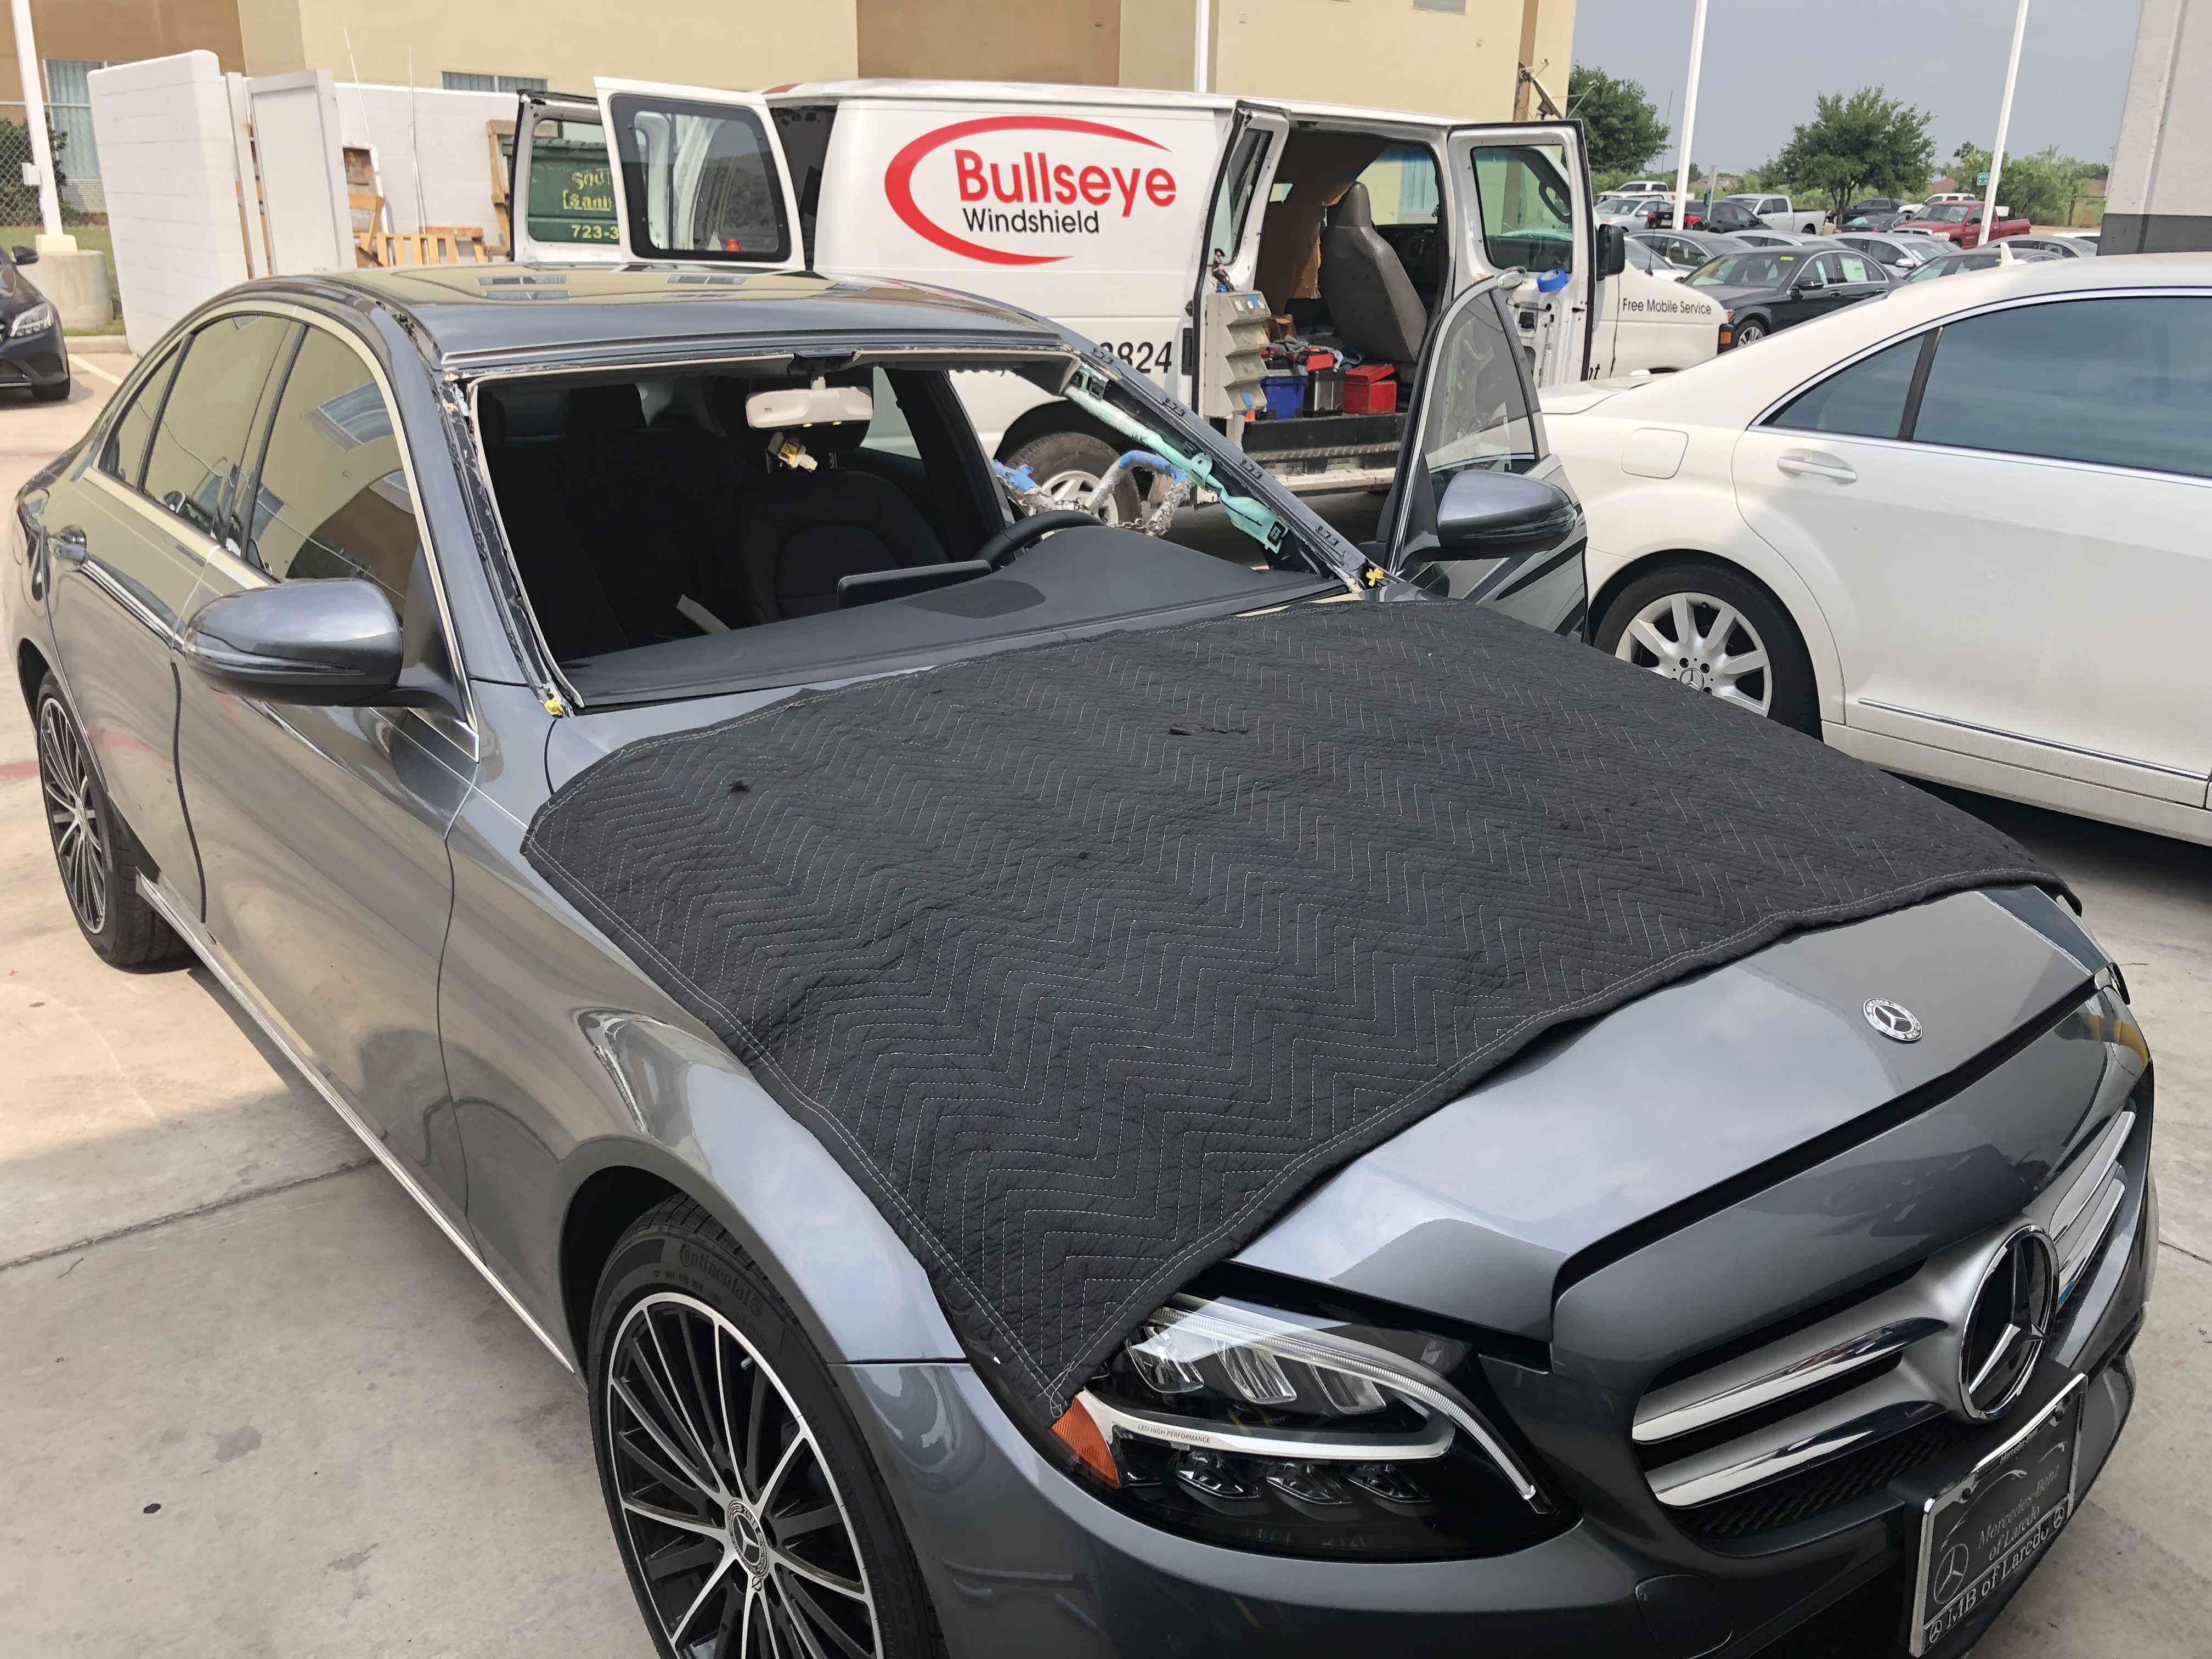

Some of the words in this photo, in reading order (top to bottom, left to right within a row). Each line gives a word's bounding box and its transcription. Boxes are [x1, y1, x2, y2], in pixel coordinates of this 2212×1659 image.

[954, 149, 1177, 218] Bullseye
[571, 224, 619, 240] 723-3
[962, 208, 1100, 233] Windshield
[1622, 298, 1644, 312] Free
[1647, 299, 1678, 313] Mobile
[1680, 301, 1712, 315] Service
[1150, 1426, 1165, 1435] HIGH
[1166, 1430, 1211, 1444] PERFORMANCE
[1978, 1464, 2060, 1549] Mercedes-Benz
[1989, 1537, 2001, 1561] of
[2004, 1506, 2040, 1548] Laredo
[1946, 1588, 1977, 1629] MB
[1981, 1565, 2000, 1597] of
[2001, 1524, 2049, 1581] Laredo
